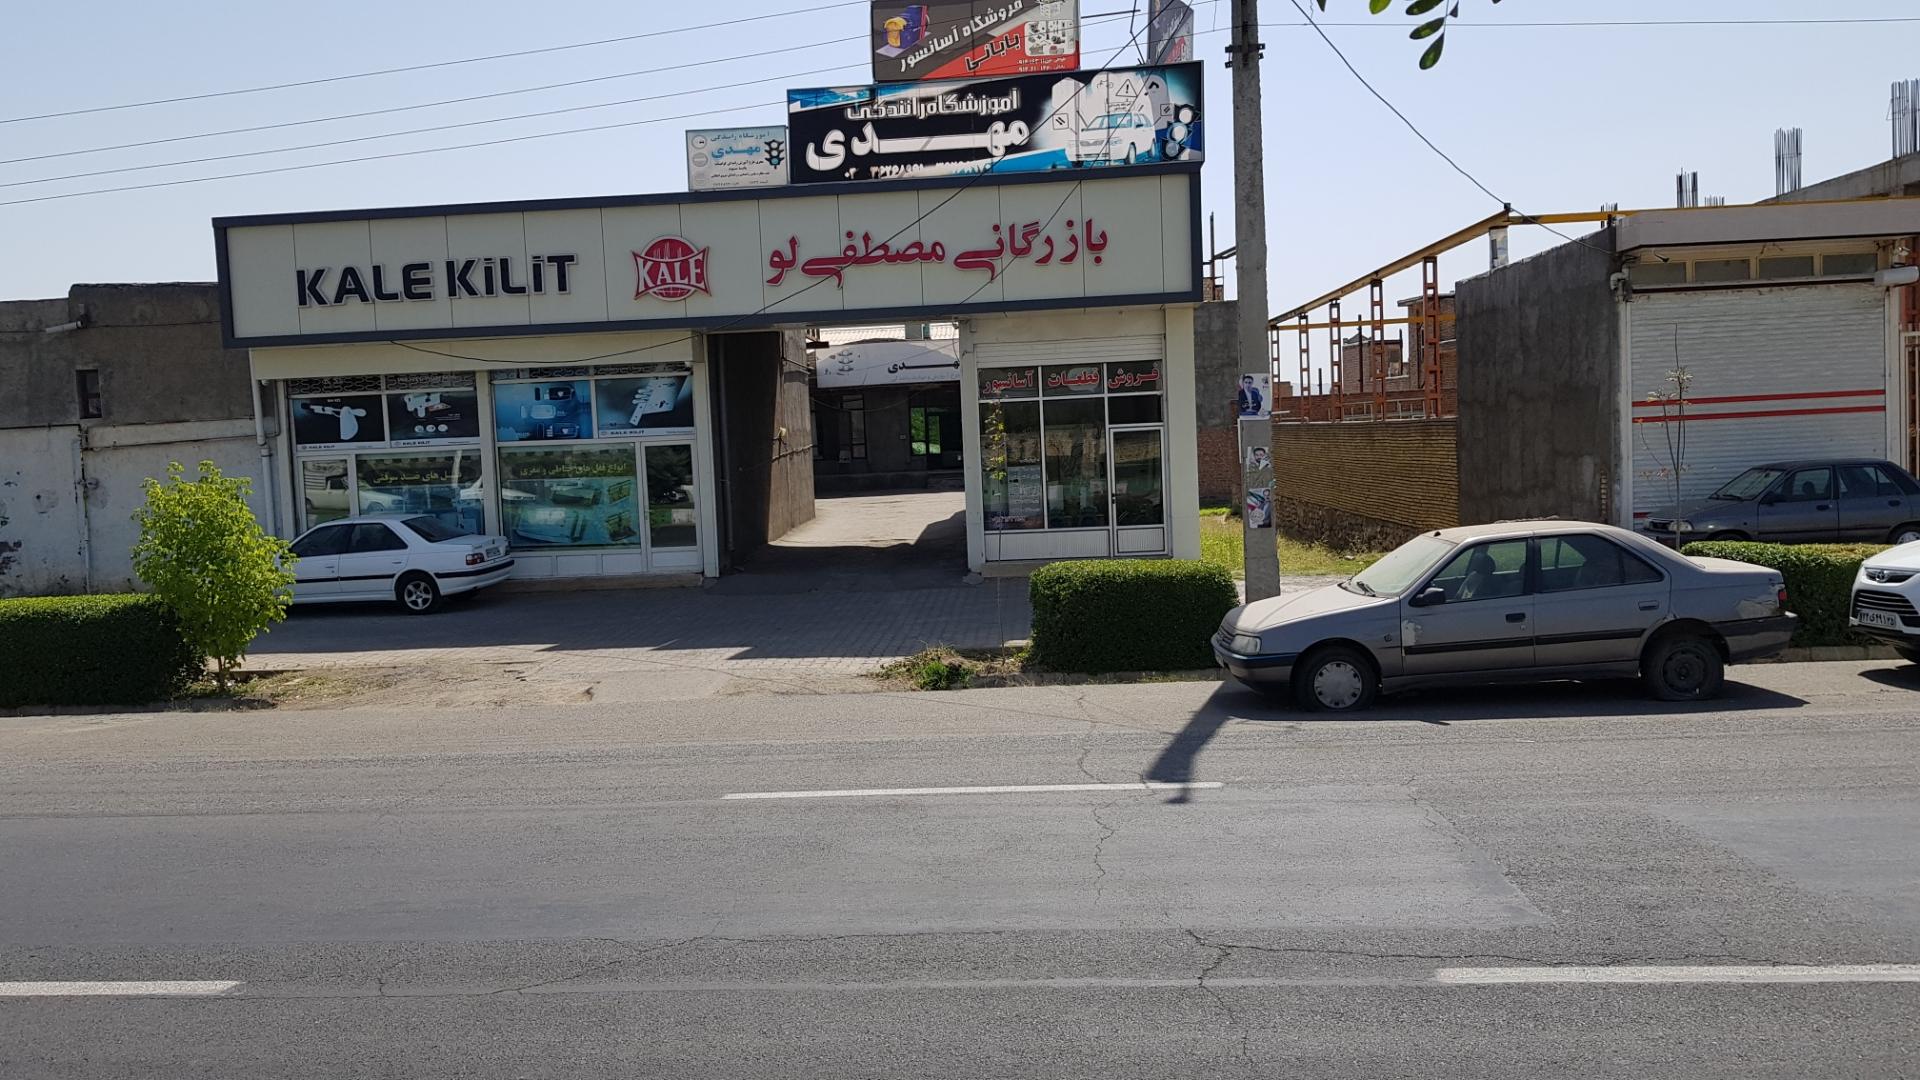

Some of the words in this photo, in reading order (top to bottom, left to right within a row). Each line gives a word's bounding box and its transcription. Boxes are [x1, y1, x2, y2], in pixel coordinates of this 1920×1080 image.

[900, 25, 959, 72] آسانسور
[847, 96, 927, 120] رانندگی
[711, 146, 761, 159] مهدی
[806, 119, 1030, 171] مهدی
[766, 233, 799, 286] لو
[801, 230, 946, 289] مصطفی
[953, 218, 1108, 284] بازرگانی
[296, 261, 434, 307] KALE
[638, 254, 706, 289] KALE
[888, 361, 960, 374] هدی
[983, 370, 1034, 394] آسانسور
[1047, 367, 1100, 387] قطعات
[1108, 361, 1160, 389] فروش
